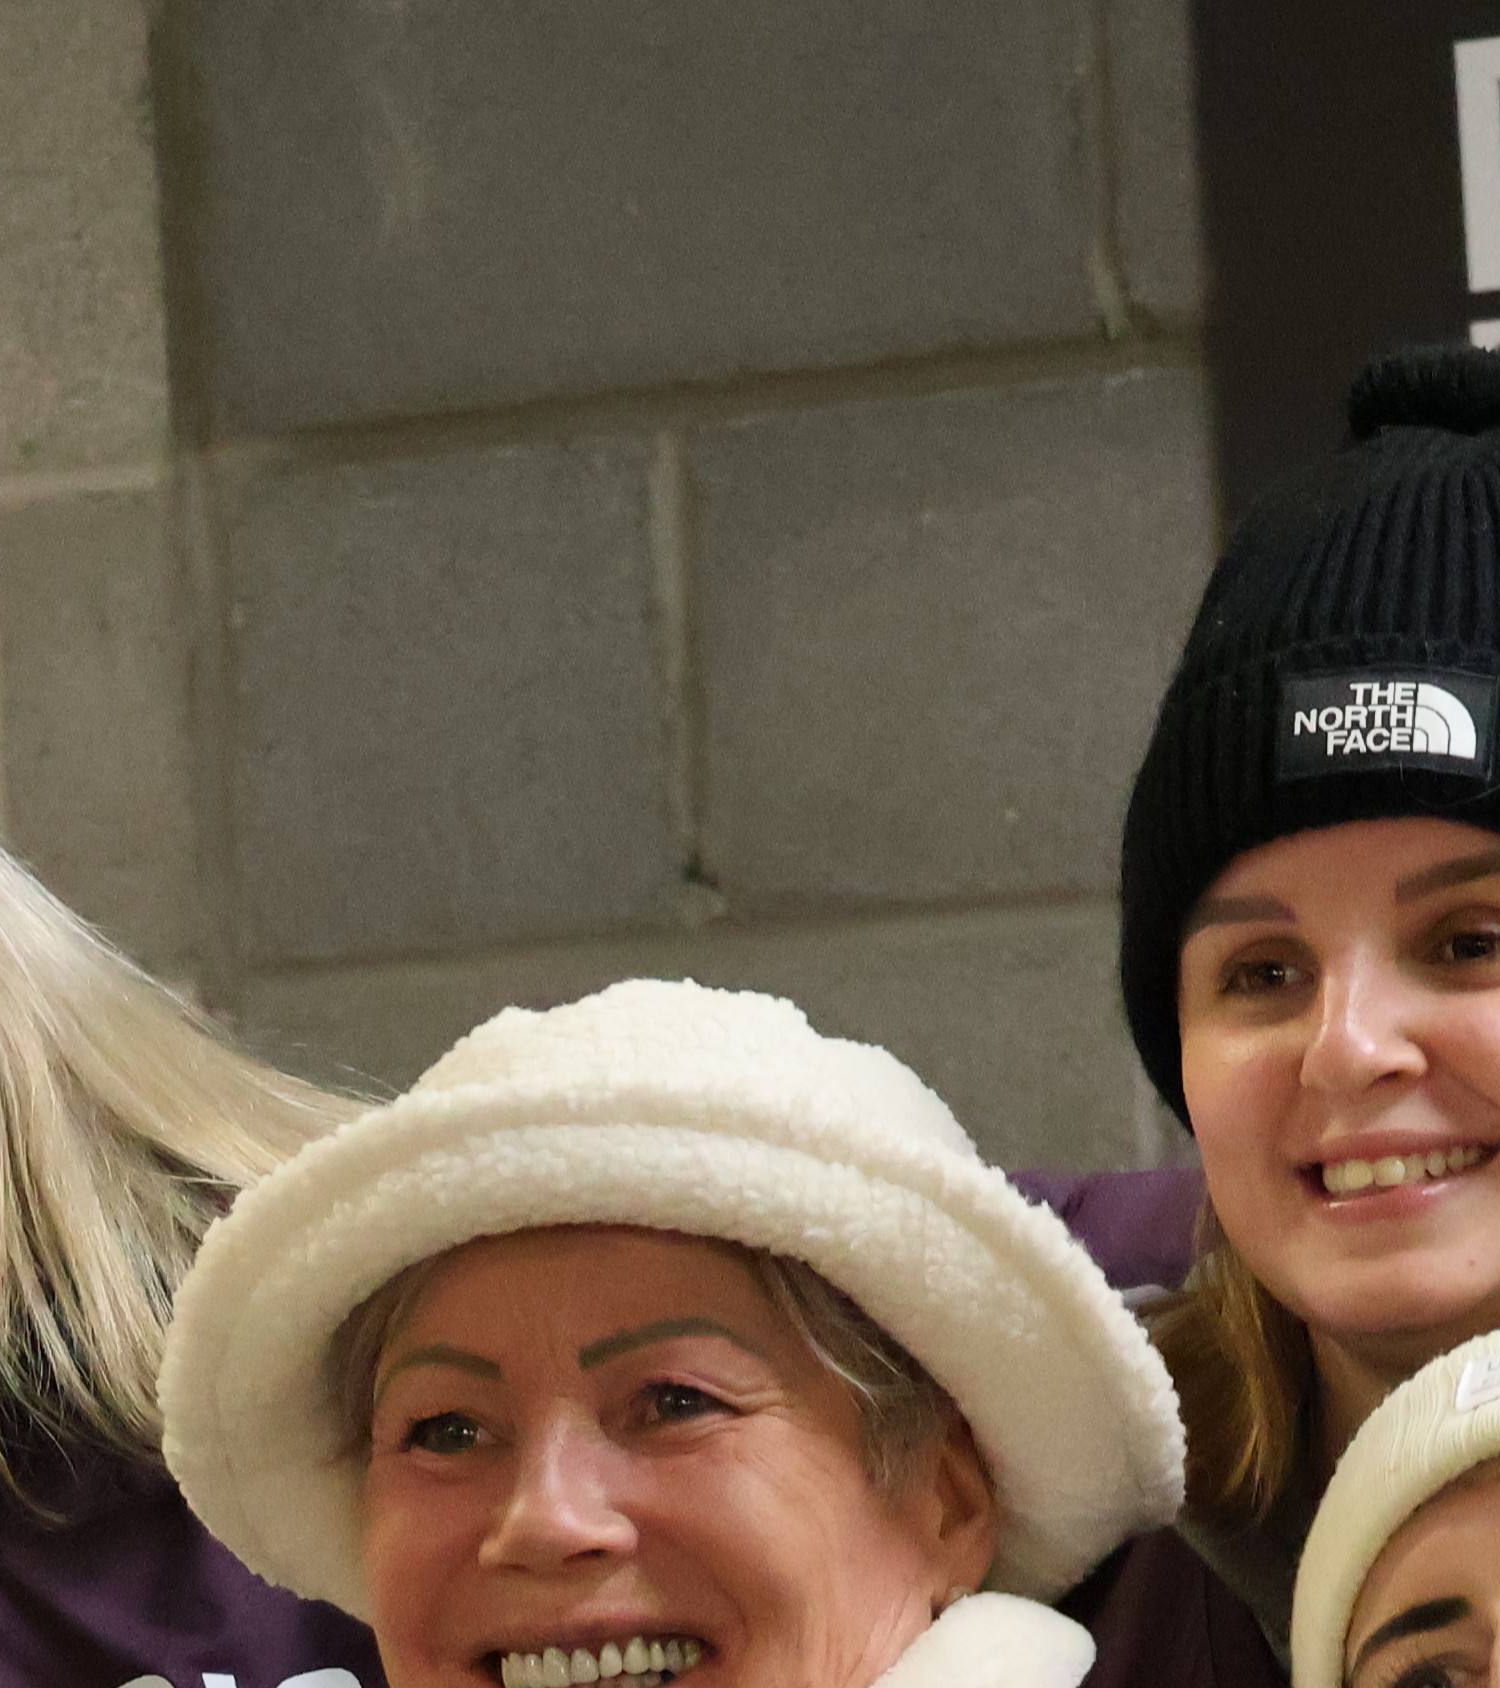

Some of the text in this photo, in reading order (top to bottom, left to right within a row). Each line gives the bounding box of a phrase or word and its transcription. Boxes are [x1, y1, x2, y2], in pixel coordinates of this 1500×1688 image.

[1350, 682, 1416, 705] THE
[1293, 705, 1413, 736] NORTH
[1326, 727, 1411, 756] FACE
